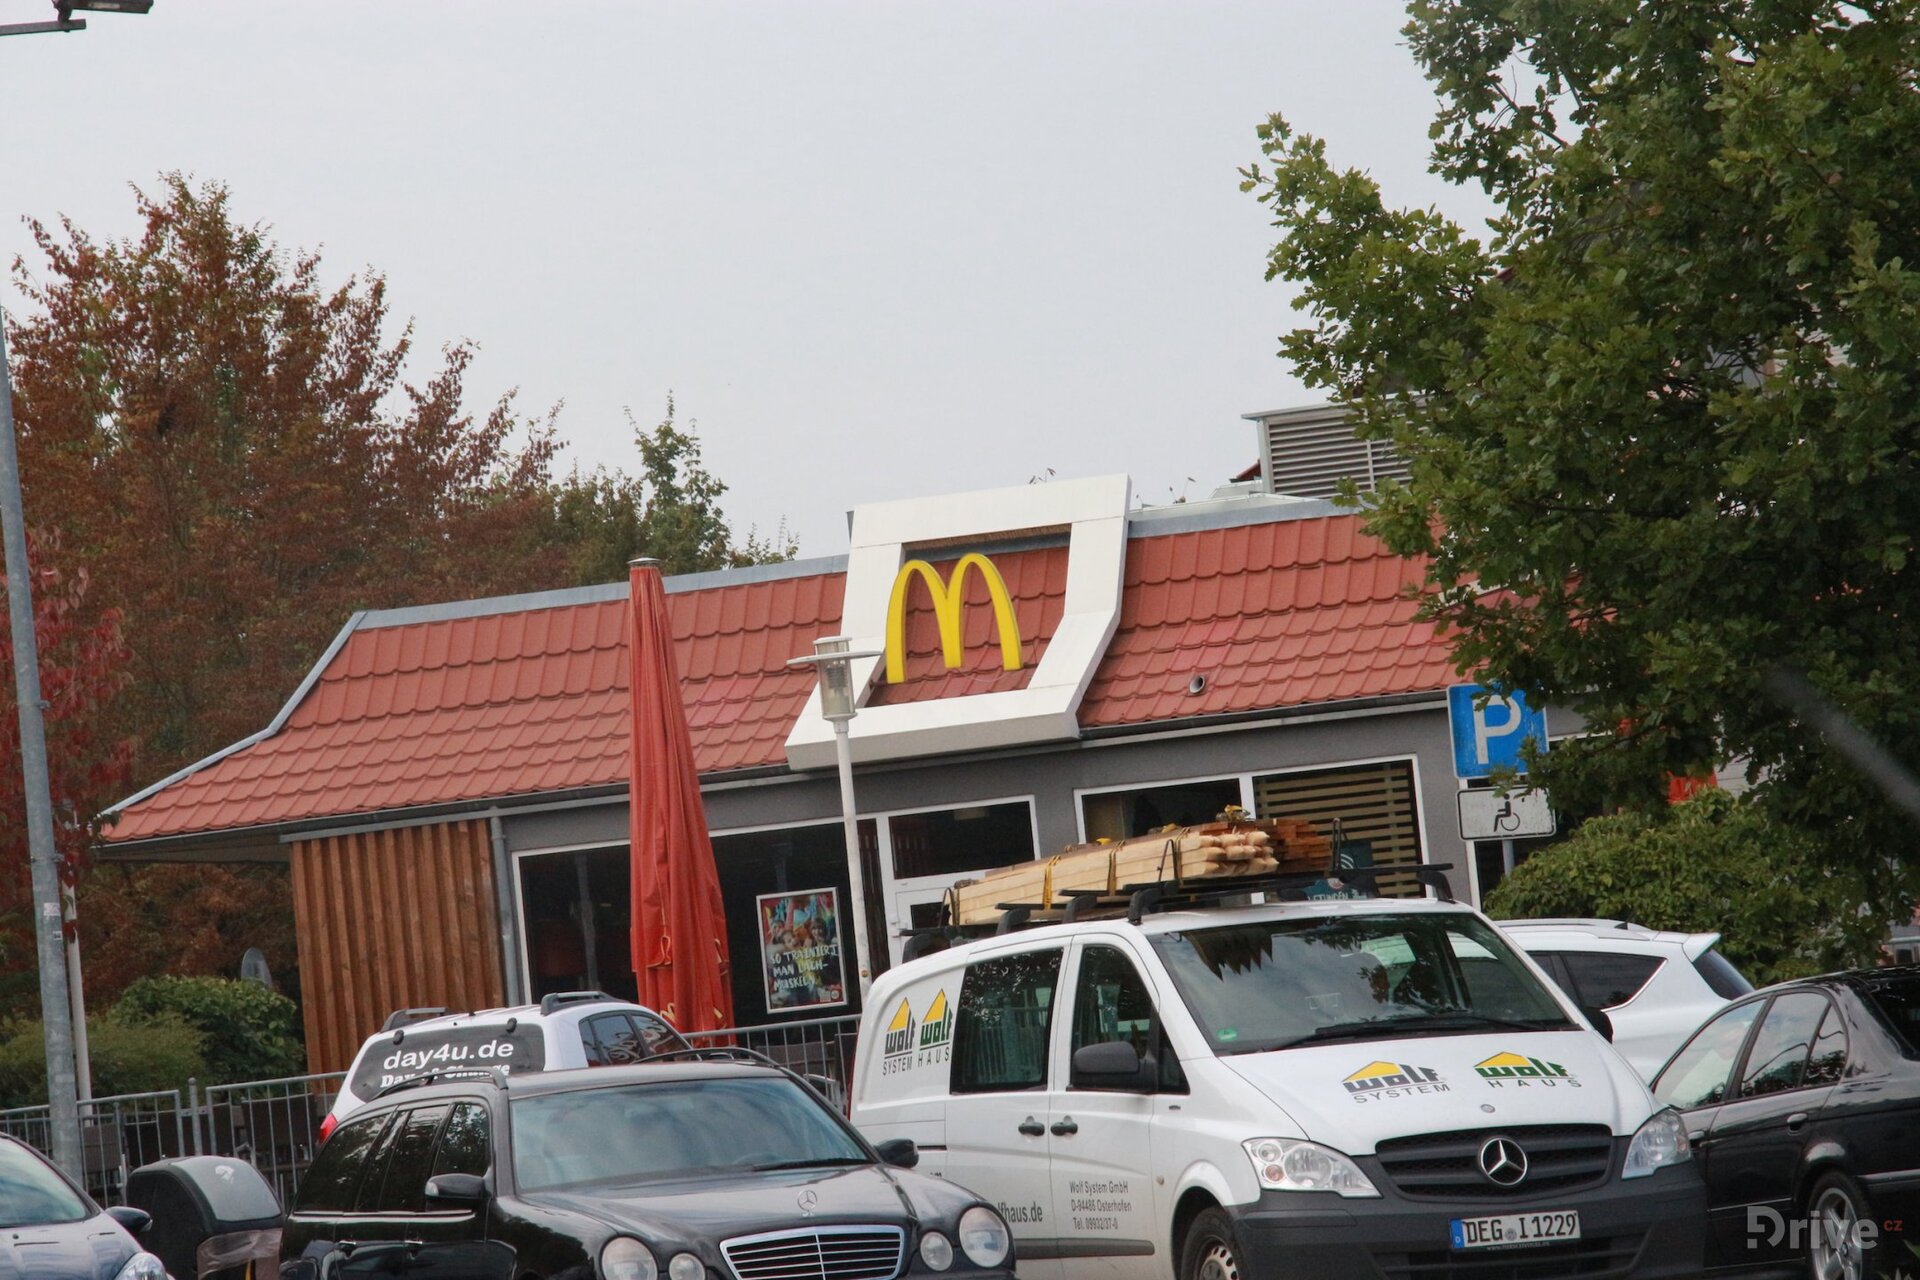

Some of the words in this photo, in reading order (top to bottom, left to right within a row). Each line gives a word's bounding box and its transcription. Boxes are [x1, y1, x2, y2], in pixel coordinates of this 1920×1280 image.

[1472, 694, 1522, 765] P
[771, 953, 782, 964] SO
[773, 964, 795, 977] MAN
[799, 959, 829, 973] LACH-
[383, 1040, 514, 1070] day4u.de
[918, 1047, 950, 1068] HAUS
[882, 1056, 913, 1076] SYSTEM
[1353, 1083, 1451, 1104] SYSTEM
[1488, 1079, 1582, 1089] HAUS
[1069, 1181, 1083, 1194] Wolf
[1084, 1181, 1108, 1197] System
[1109, 1180, 1129, 1194] GmbH
[1097, 1198, 1132, 1212] Osterhofen
[1072, 1217, 1085, 1230] Tel.
[1466, 1219, 1504, 1244] DEG
